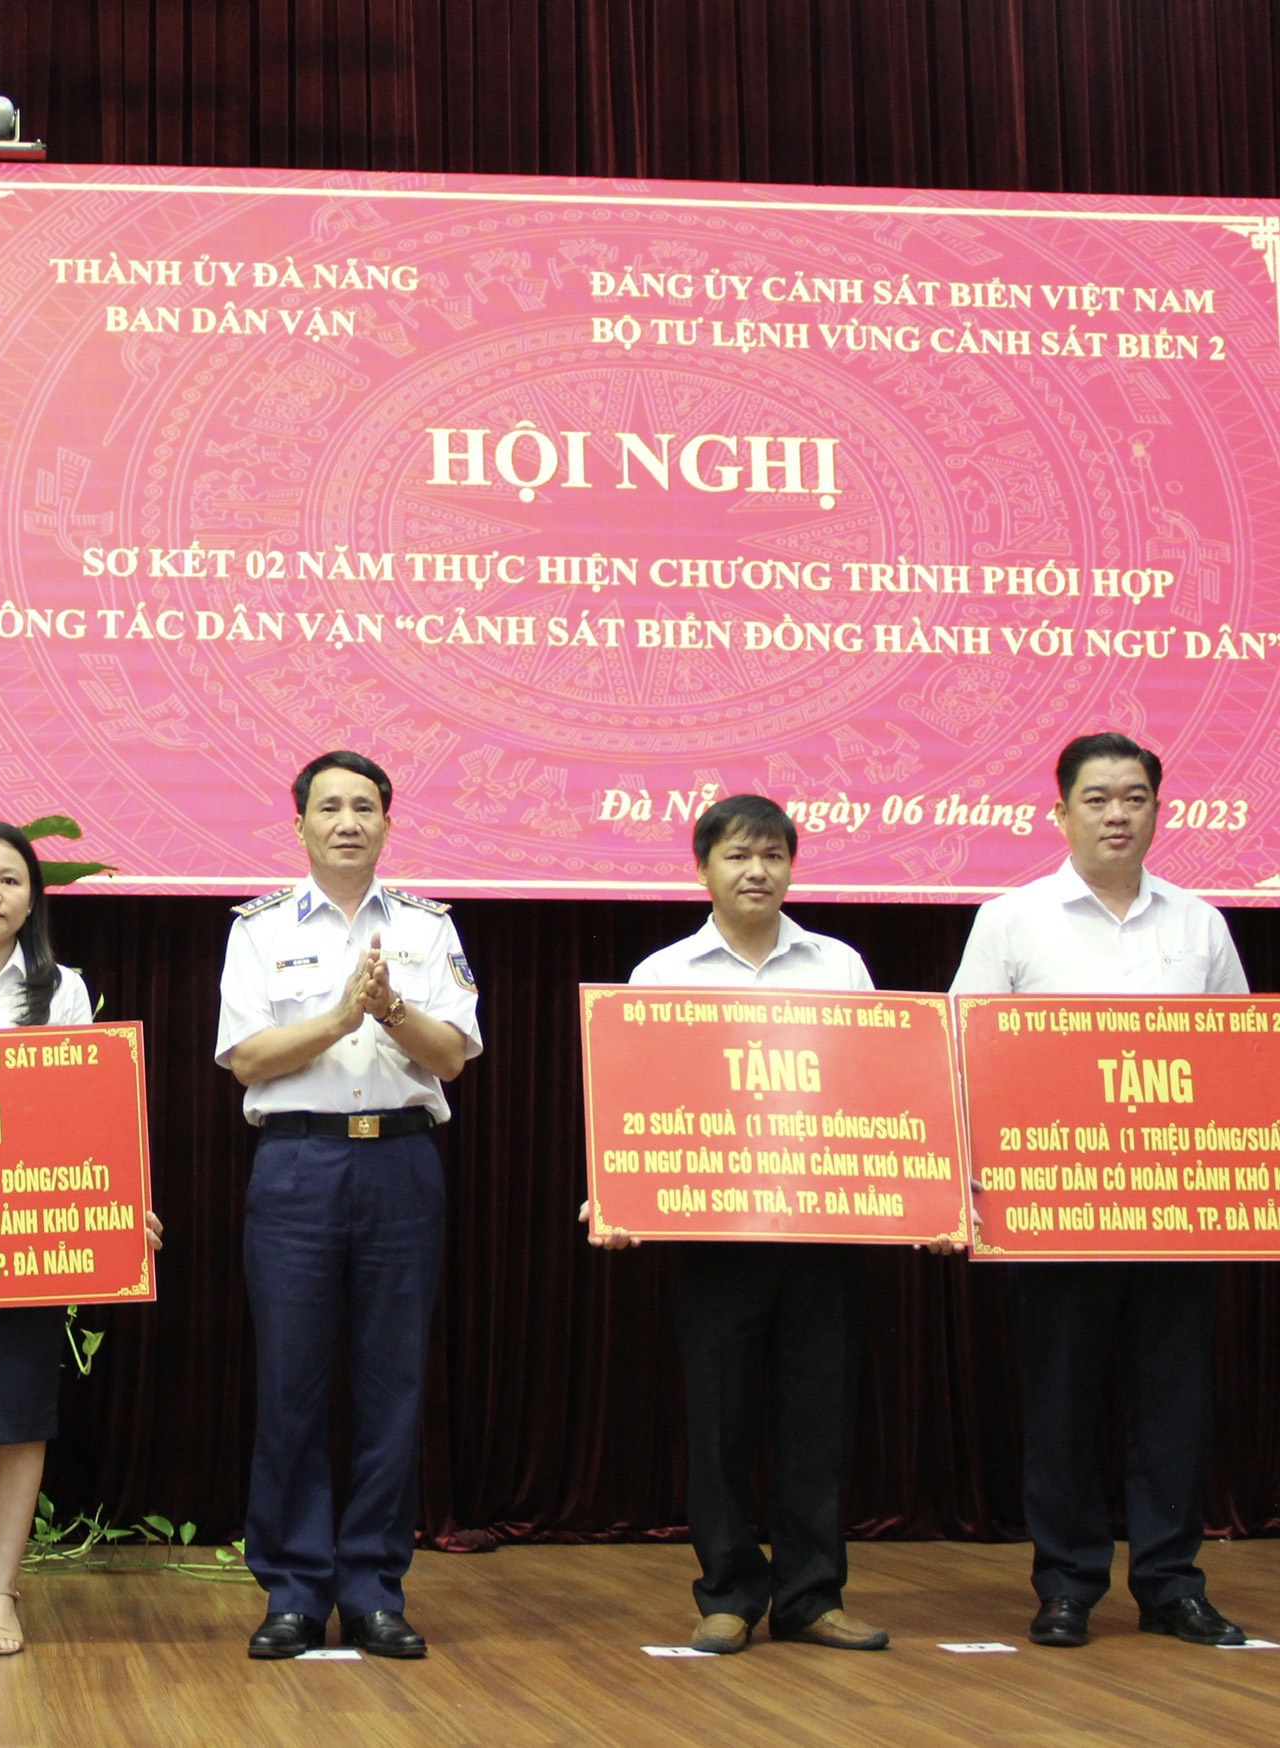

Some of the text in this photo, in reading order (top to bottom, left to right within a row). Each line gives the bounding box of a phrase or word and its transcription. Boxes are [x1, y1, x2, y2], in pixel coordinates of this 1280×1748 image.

[49, 252, 418, 291] THÀNH ỦY ĐÀ NẴNG
[589, 265, 1214, 315] ĐẢNG ỦY CẢNH SÁT BIỂN VIỆT NAM
[105, 301, 355, 342] BAN DÂN VẬN
[591, 314, 1225, 360] BỘ TƯ LỆNH VÙNG CẢNH SÁT BIỂN 2
[424, 419, 841, 510] HỘI NGHỊ
[81, 537, 1173, 604] SƠ KẾT 02 NĂM THỰC HIỆN CHƯƠNG TRÌNH PHỐI HỢP
[96, 600, 184, 639] TÁC
[194, 602, 285, 641] DÂN
[294, 608, 384, 649] VẬN
[395, 606, 536, 645] “CẢNH
[547, 609, 624, 647] SÁT
[635, 612, 731, 649] BIỂN
[743, 613, 863, 651] ĐỒNG
[872, 616, 990, 654] HÀNH
[1000, 619, 1073, 656] VỚI
[1084, 626, 1175, 657] NGƯ
[597, 788, 652, 822] Đà
[662, 783, 719, 822] Nẵ
[786, 792, 871, 833] ngày
[882, 795, 923, 826] 06
[933, 794, 1037, 834] tháng
[1164, 799, 1249, 831] 2023
[997, 1004, 1280, 1035] BỘ TƯ LỆNH VÙNG CẢNH SÁT BIỂN 2
[4, 1043, 37, 1068] SÁT
[41, 1037, 82, 1066] BIỂN
[87, 1044, 98, 1064] 2
[723, 1039, 820, 1100] TẶNG
[1097, 1049, 1193, 1112] TẶNG
[1, 1156, 109, 1193] ĐỒNG/SUẤT)
[603, 1145, 951, 1179] CHO NGƯ DÂN CÓ HOÀN CẢNH KHÓ KHĂN
[42, 1202, 79, 1232] KHÓ
[84, 1200, 133, 1231] KHĂN
[657, 1184, 903, 1216] QUẬN SƠN TRÀ, TP. ĐÀ NẴNG
[1005, 1198, 1280, 1235] QUẬN NGŨ HÀNH SƠN, TP. ĐÀ NẴ
[13, 1245, 38, 1275] ĐÀ
[43, 1240, 94, 1274] NẴNG
